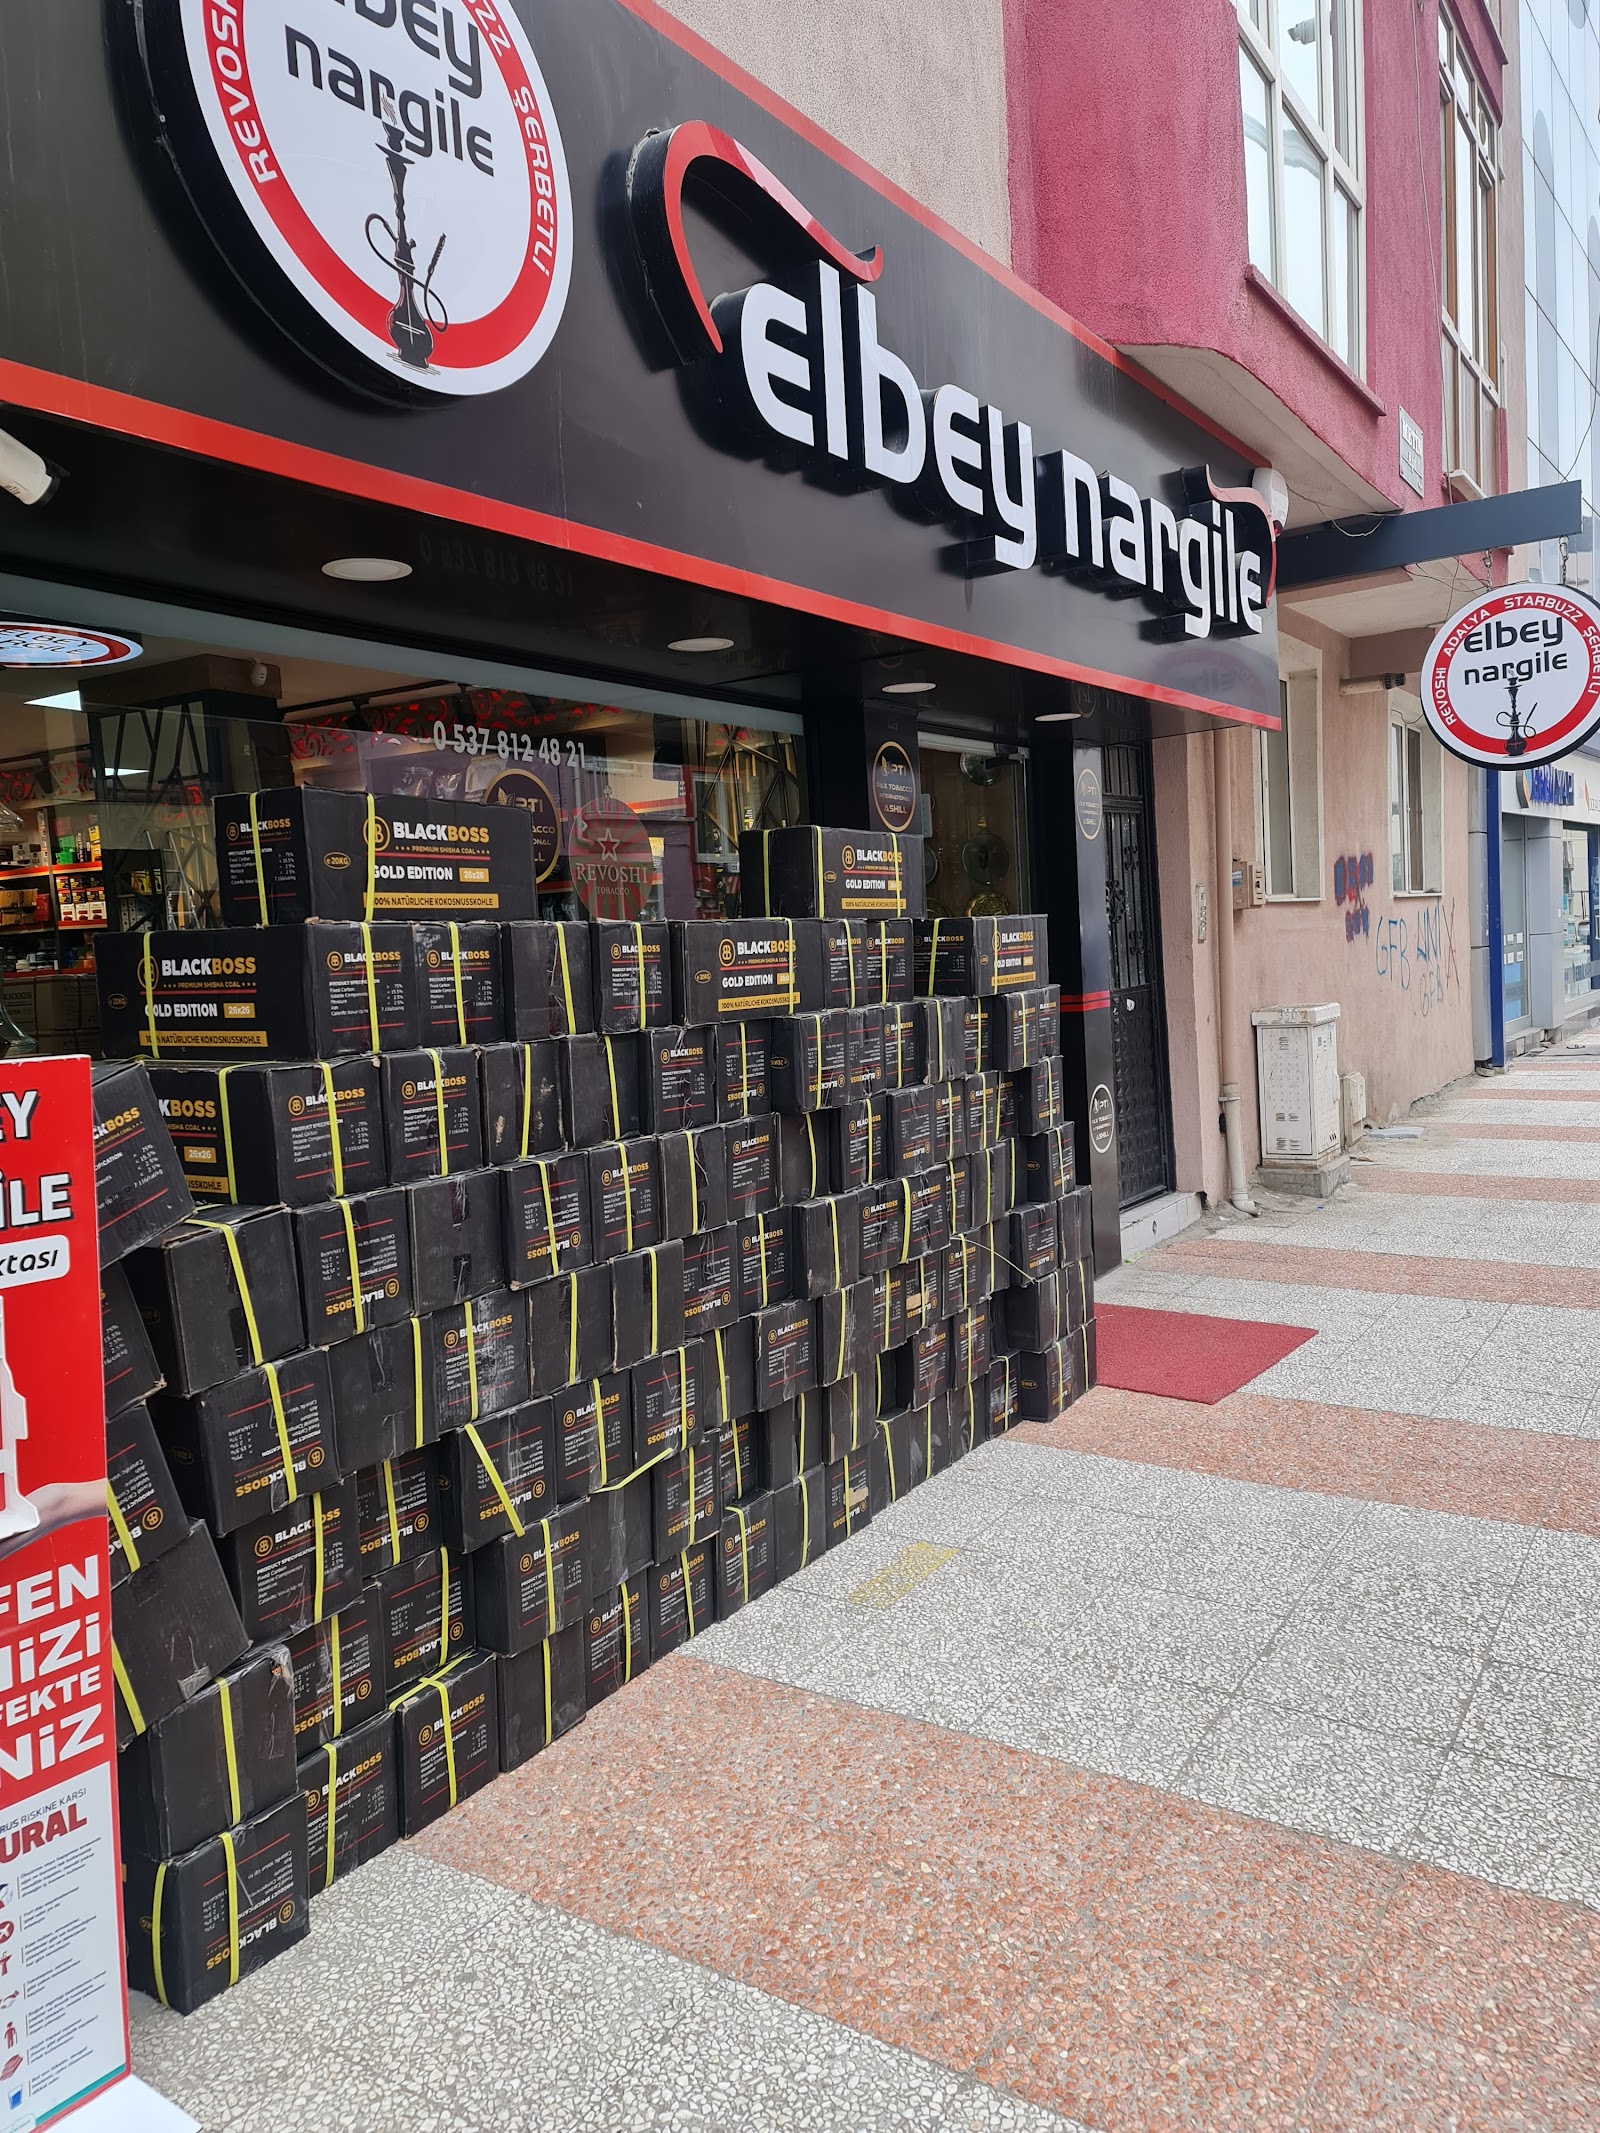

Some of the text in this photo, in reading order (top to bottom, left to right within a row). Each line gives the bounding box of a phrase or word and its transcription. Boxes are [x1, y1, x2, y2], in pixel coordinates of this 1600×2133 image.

[285, 24, 494, 177] nargile
[741, 259, 1262, 637] elbey nargile
[1504, 595, 1583, 622] STARBUZZ
[1443, 609, 1491, 656] ADALYA
[1463, 617, 1562, 653] elbey
[1464, 650, 1567, 685] nargile
[1435, 667, 1457, 725] REVOSHI
[433, 721, 585, 768] 0 537 812 48 21
[891, 763, 906, 776] PTI
[888, 784, 912, 792] TOBACCO
[393, 821, 489, 843] BLACKBOSS
[412, 845, 438, 853] PREMIUM
[407, 866, 453, 880] EDITION
[576, 862, 648, 884] REVOSHI
[596, 886, 630, 896] TOBACCO
[845, 879, 885, 889] GOLD EDITION
[392, 895, 433, 906] NATÜRLICHE
[434, 897, 493, 906] KOKOSNUSSKOHLE
[1002, 931, 1033, 943] BLACKBOSS
[162, 957, 256, 976] BLACKBOSS
[722, 974, 773, 987] GOLD EDITION
[174, 1003, 218, 1017] EDITION
[228, 1006, 250, 1014] 26x26
[734, 999, 759, 1008] NATÜRLICHE
[161, 1032, 261, 1044] NATÜRLICHE KOKOSNUSSKOHLE
[670, 1047, 703, 1058] BLACKBOSS
[742, 1135, 769, 1148] BLACKBOSS
[188, 1150, 211, 1158] 26x26
[871, 1200, 898, 1212] BLACKBOSS
[684, 1299, 721, 1317] BLACKBOSS
[778, 1318, 808, 1335] BLACKBOSS
